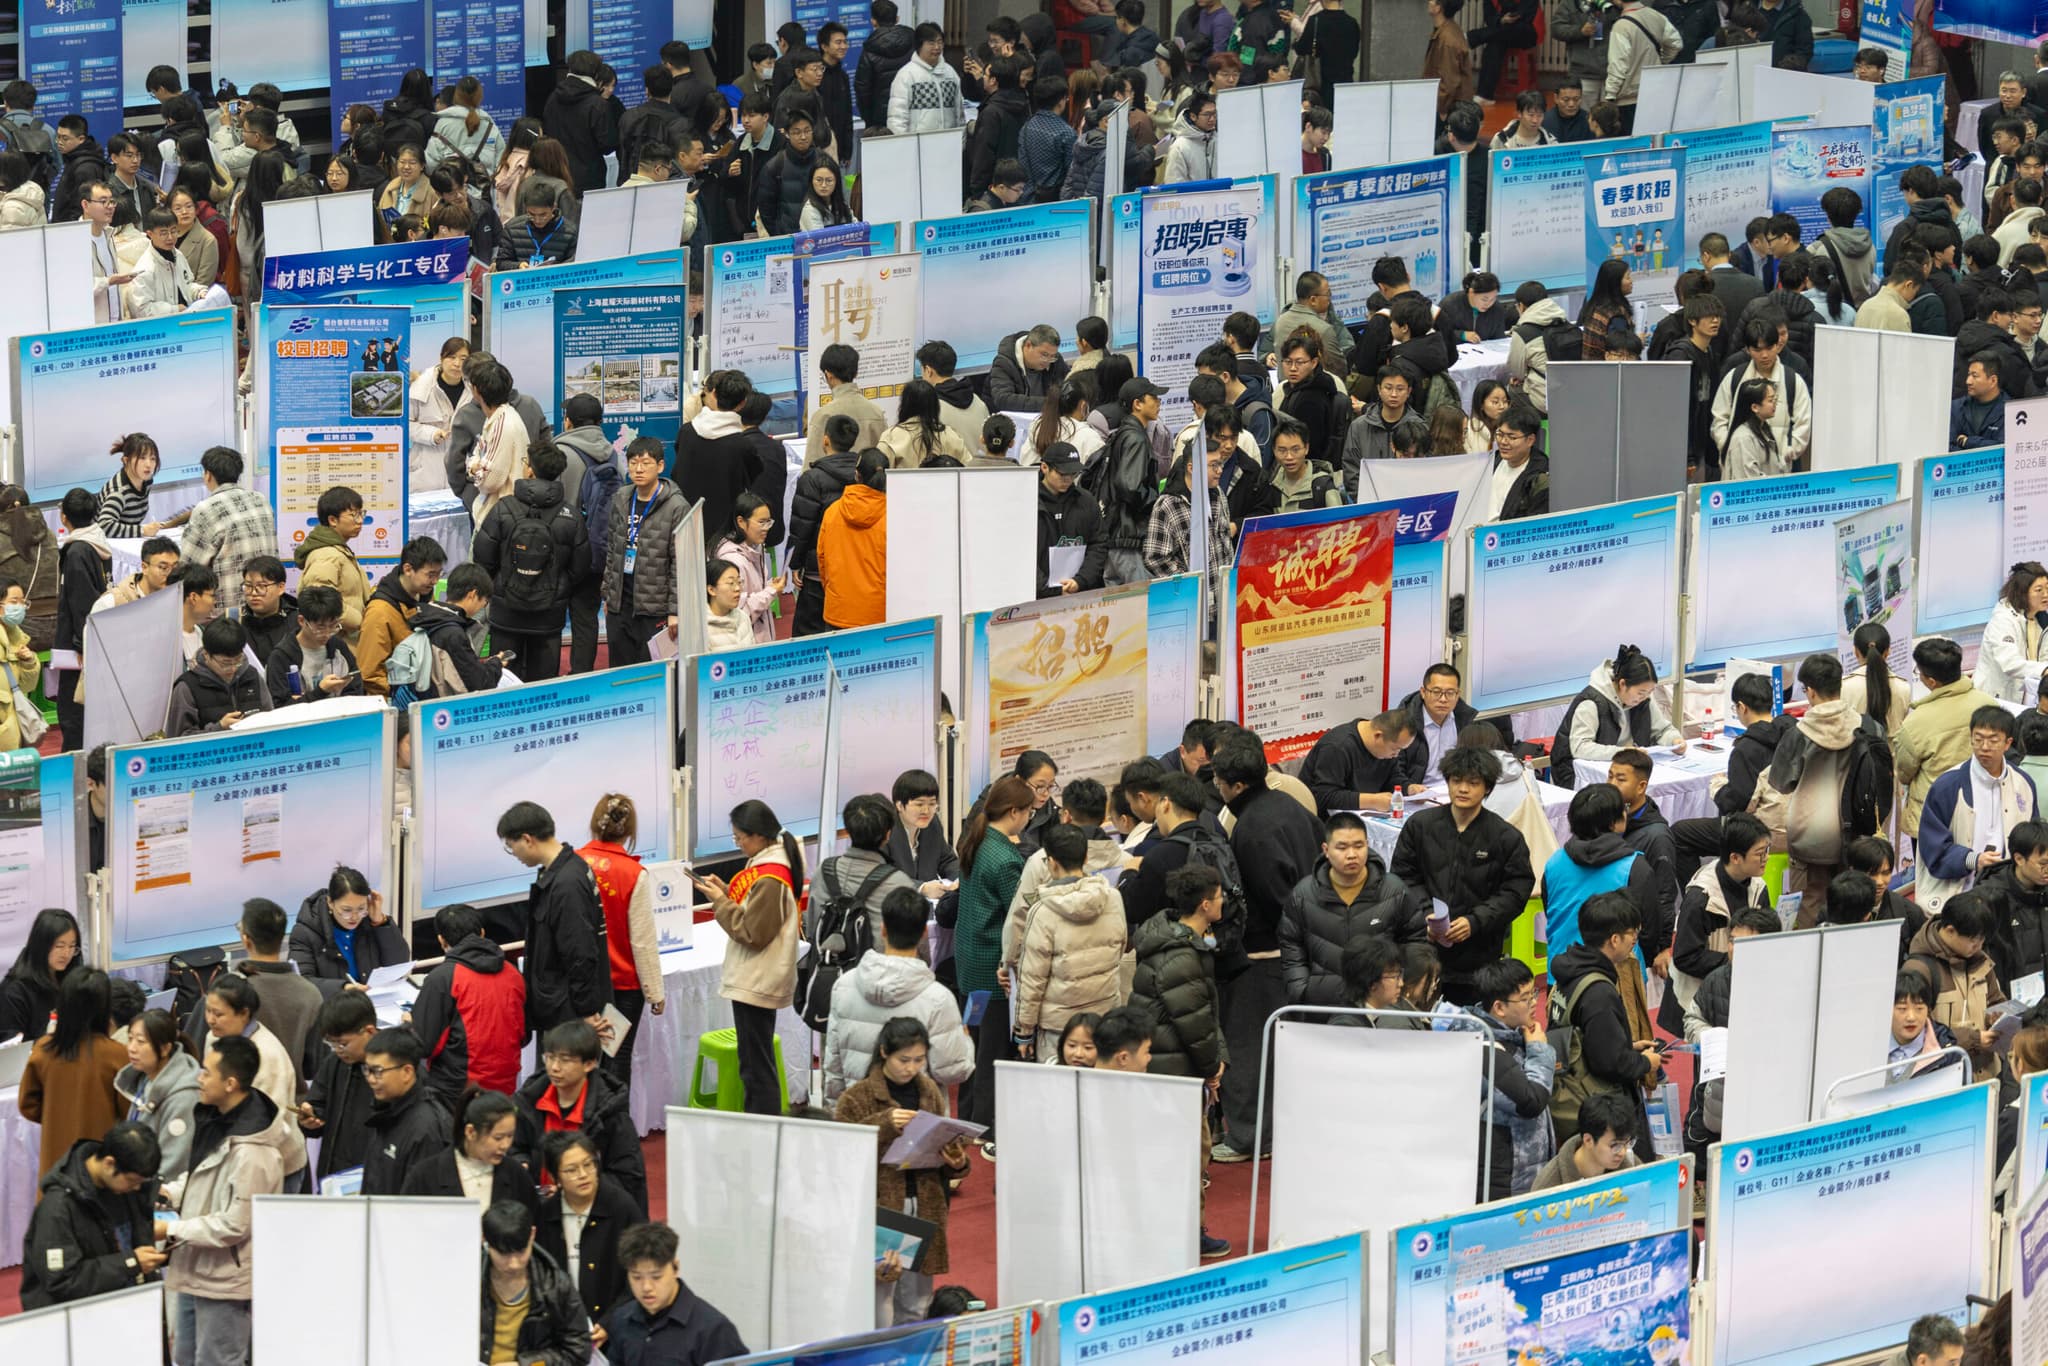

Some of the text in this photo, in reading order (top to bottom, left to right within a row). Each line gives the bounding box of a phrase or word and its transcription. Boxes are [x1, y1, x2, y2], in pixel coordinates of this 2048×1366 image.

[1343, 173, 1412, 199] 春季校招
[1602, 180, 1671, 206] 春季校招
[1611, 202, 1663, 218] 欢迎加入我们
[1153, 217, 1249, 256] 招聘启事
[277, 253, 452, 291] 材料科学与化工专区
[1161, 272, 1200, 286] 招聘岗位
[277, 339, 349, 358] 校园招聘
[712, 684, 758, 699] 展位号：E10
[437, 734, 485, 750] 展位号：E11
[513, 732, 579, 752] 企业简介/岗位要求
[130, 782, 183, 798] 展位号：E12
[213, 782, 289, 802] 企业简介/岗位要求
[1737, 1175, 1788, 1196] 展位号：G11
[1818, 1170, 1891, 1197] 企业简介/岗位要求
[1543, 1263, 1650, 1309] 正泰集团2026届校招
[1543, 1302, 1588, 1324] 加入我们
[1079, 1335, 1137, 1358] 展位号：G13
[1172, 1328, 1254, 1359] 企业简介/岗位要求
